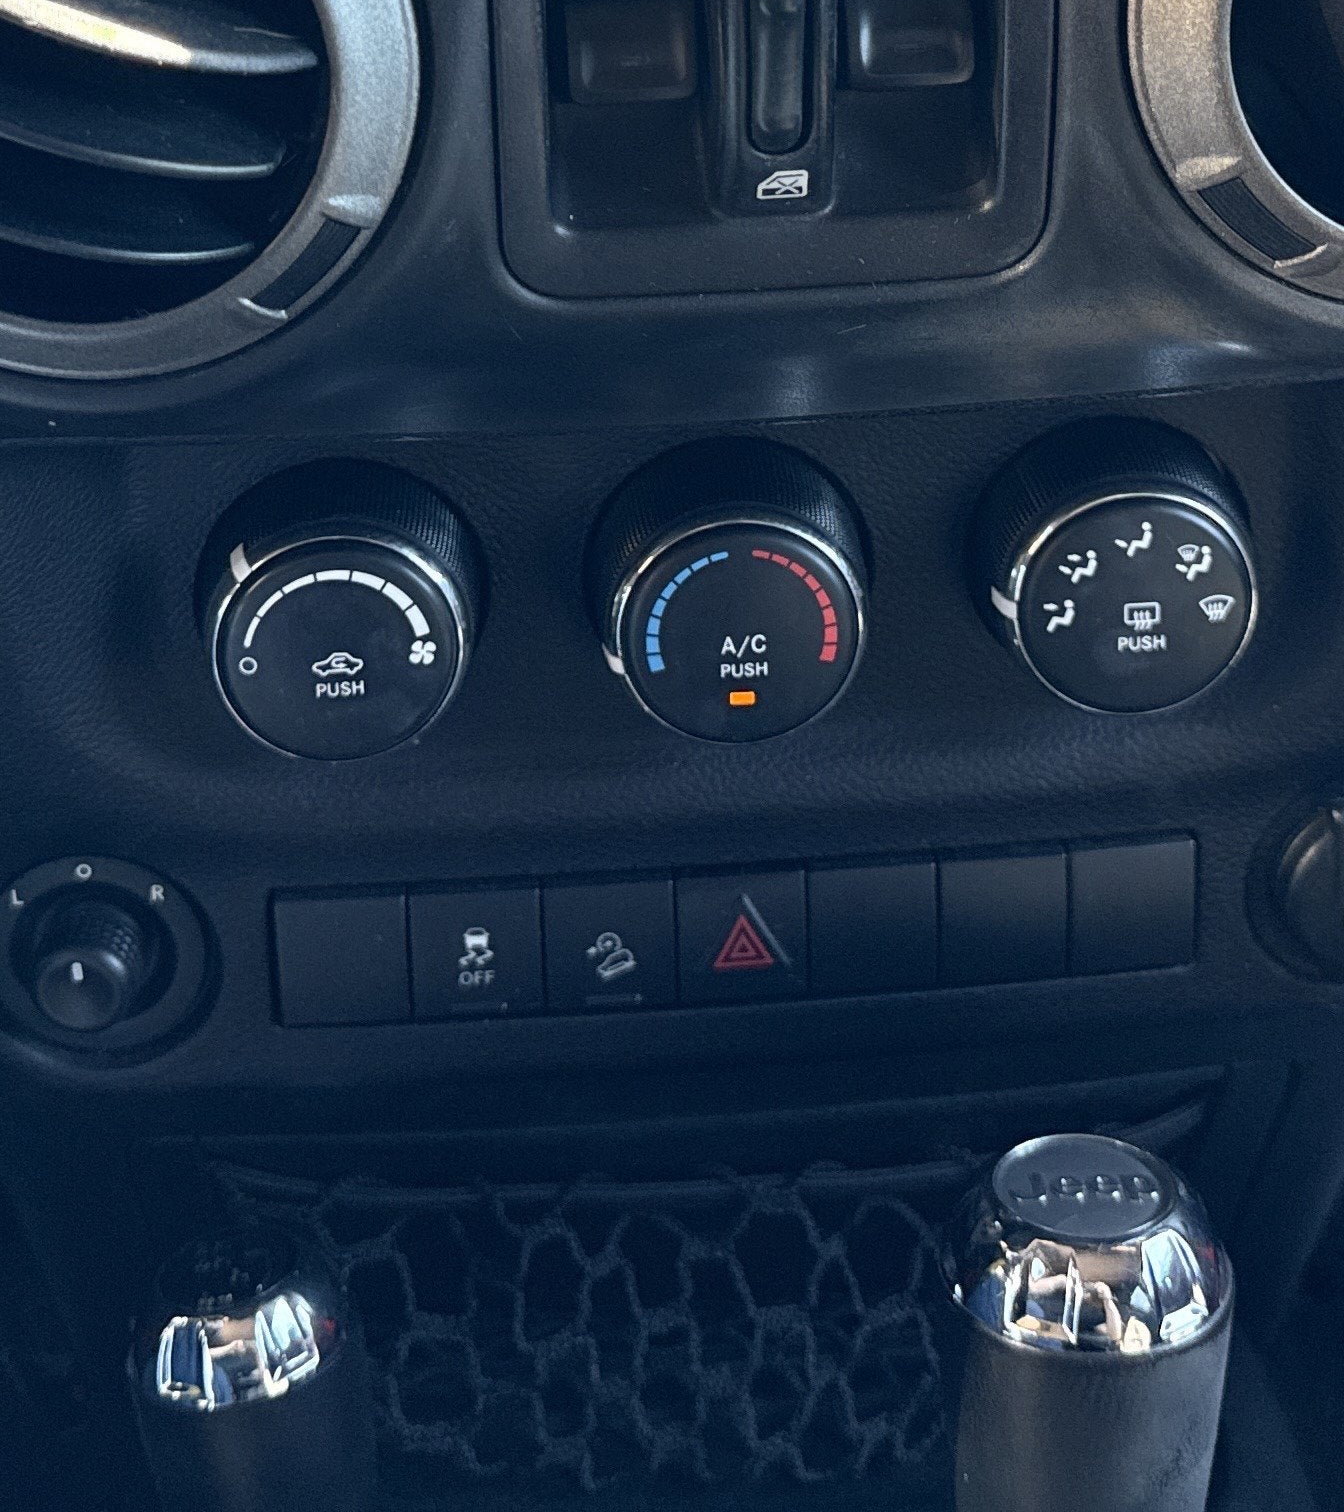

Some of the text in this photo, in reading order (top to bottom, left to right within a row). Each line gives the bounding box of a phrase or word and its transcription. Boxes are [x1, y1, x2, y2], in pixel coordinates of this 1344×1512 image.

[721, 634, 767, 655] A/C
[1117, 634, 1166, 652] PUSH
[719, 660, 769, 678] PUSH
[316, 680, 365, 698] PUSH
[9, 889, 24, 906] L
[150, 884, 164, 902] R
[459, 970, 495, 985] OFF
